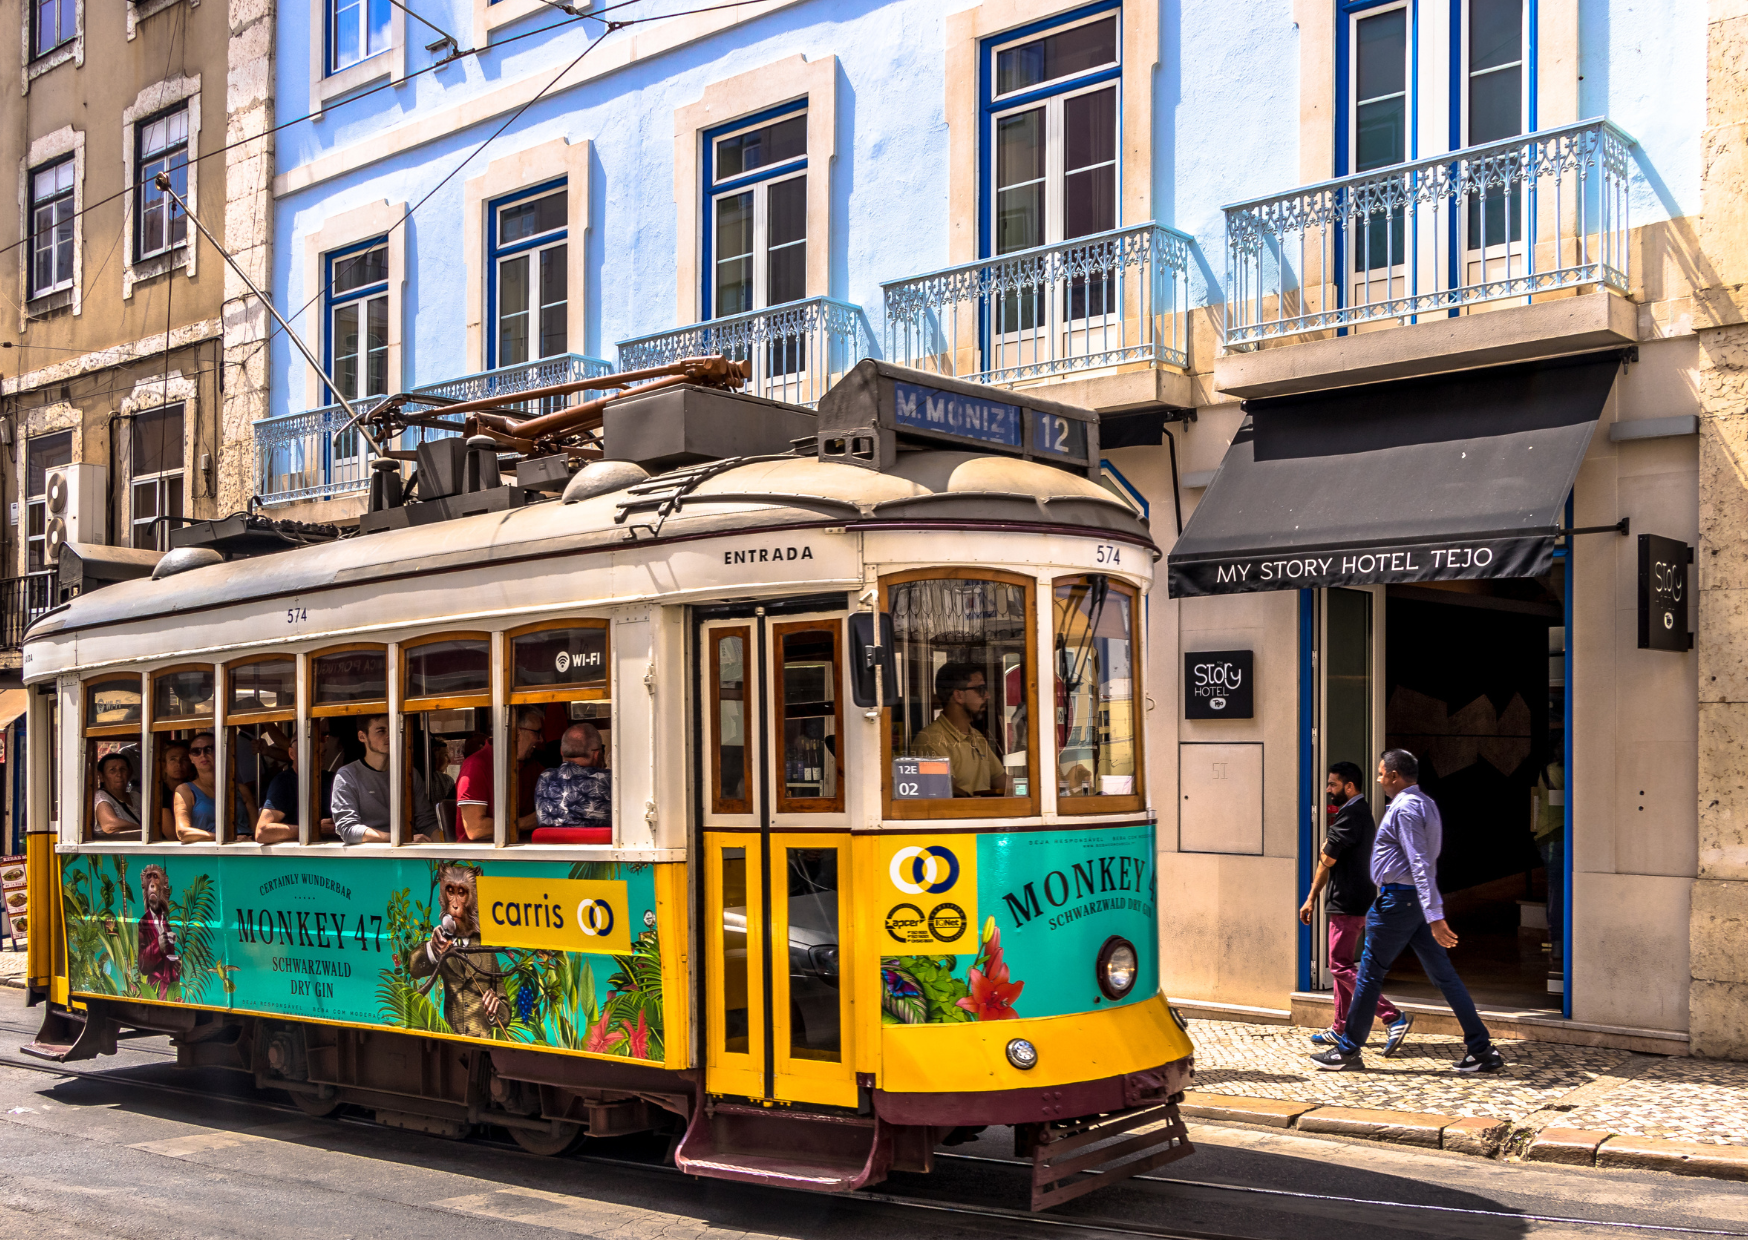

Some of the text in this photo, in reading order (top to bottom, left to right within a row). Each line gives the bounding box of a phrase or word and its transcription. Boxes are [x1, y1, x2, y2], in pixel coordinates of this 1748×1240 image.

[897, 390, 1005, 433] M. MONIZ
[1041, 416, 1069, 453] 12
[724, 546, 814, 565] ENTRADA
[1096, 545, 1121, 565] 574
[1216, 547, 1493, 583] MY STORY HOTEL TEJO
[287, 607, 307, 623] 574
[572, 652, 600, 667] WI-FI
[1194, 686, 1230, 697] HOTEL
[105, 699, 121, 710] WI-FI
[898, 765, 918, 775] 12E
[899, 782, 919, 796] 02
[259, 873, 352, 900] CERTAINLY WUNDERBAR
[1002, 856, 1146, 929] MONKEY
[492, 893, 564, 929] carris
[1048, 897, 1126, 931] SCHWARZWALD
[1127, 898, 1142, 912] DRY
[236, 908, 382, 953] MONKEY 47
[892, 920, 918, 929] apcer
[272, 956, 352, 978] SCHWARZWALD
[290, 980, 334, 998] DRY GIN
